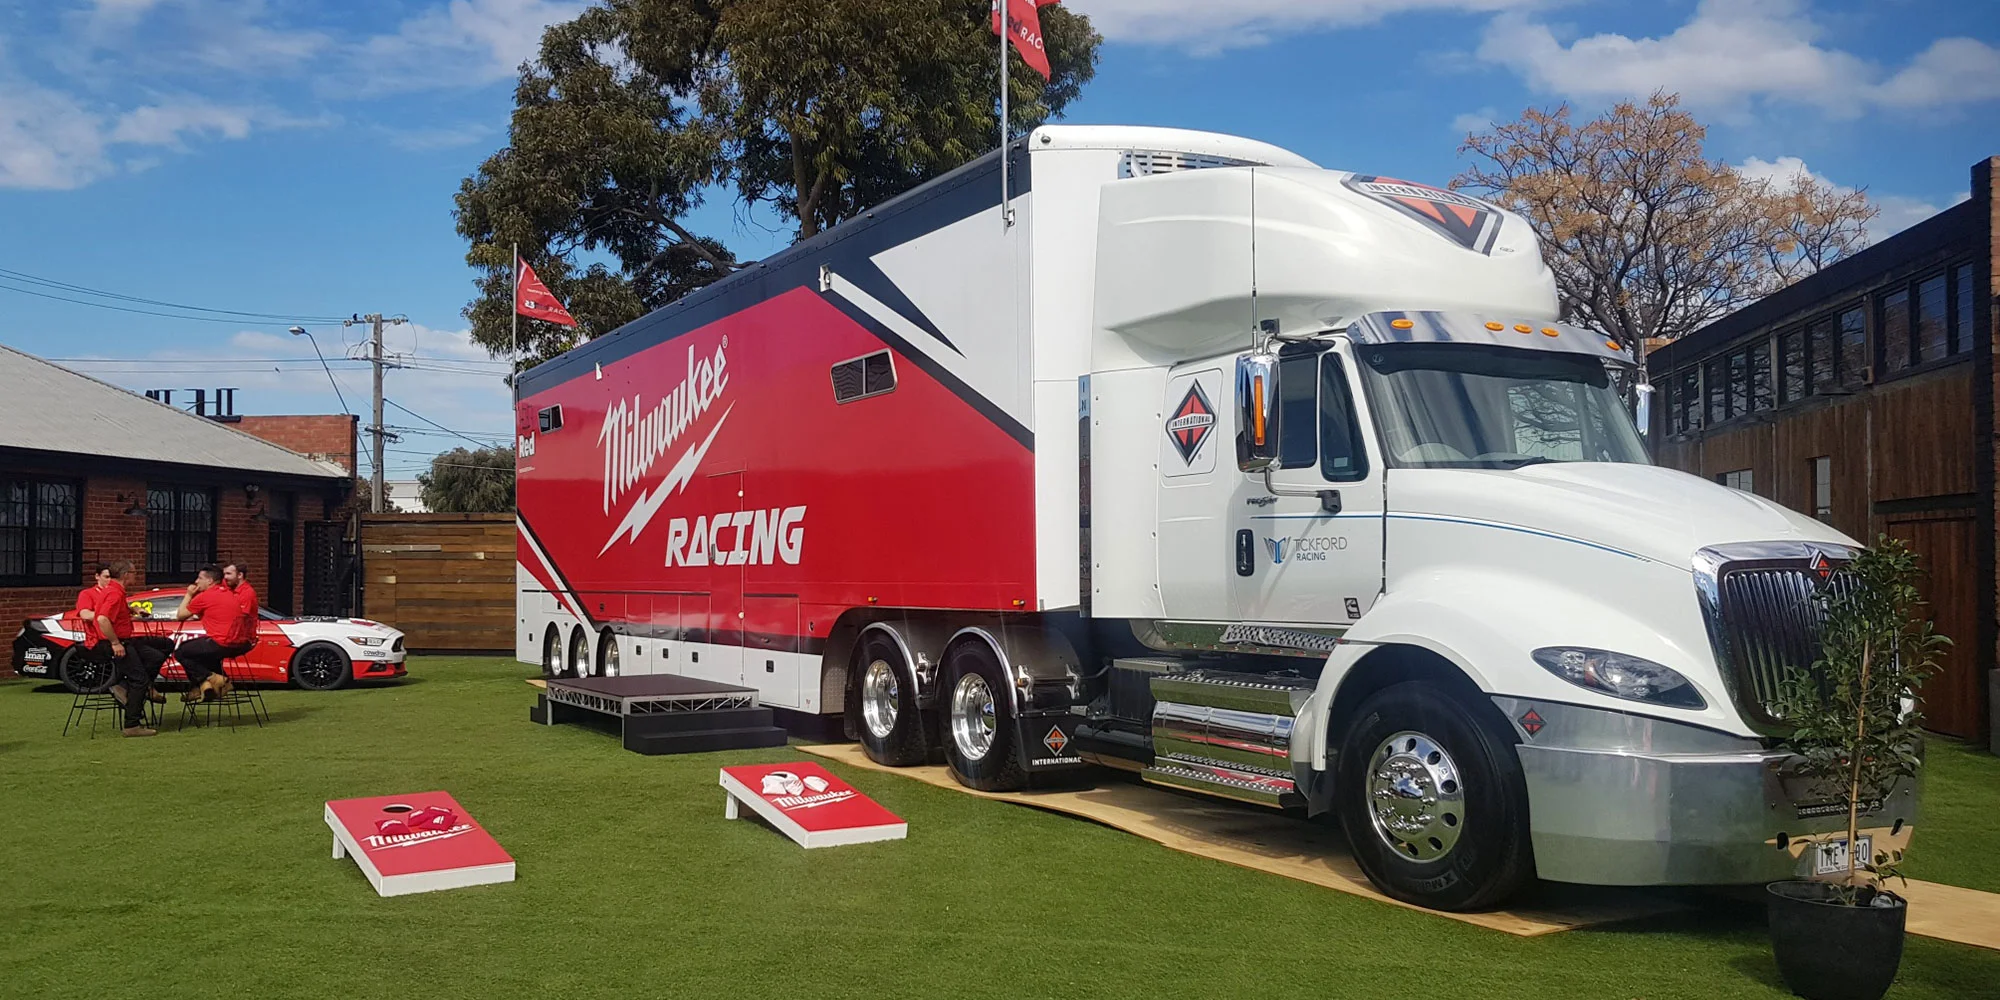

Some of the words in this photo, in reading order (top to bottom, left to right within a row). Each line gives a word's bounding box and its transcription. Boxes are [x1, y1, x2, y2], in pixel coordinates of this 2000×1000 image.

[1366, 183, 1486, 210] INTERNATIONAL
[596, 343, 730, 517] Milwaukee
[1172, 415, 1211, 428] INTERNATIONAL
[519, 431, 535, 458] Red
[664, 505, 807, 567] RACING
[1293, 537, 1347, 551] TICKFORD
[1296, 552, 1326, 561] RACING
[1031, 756, 1082, 766] INTERNATIONAL
[771, 790, 855, 807] Milwaukee
